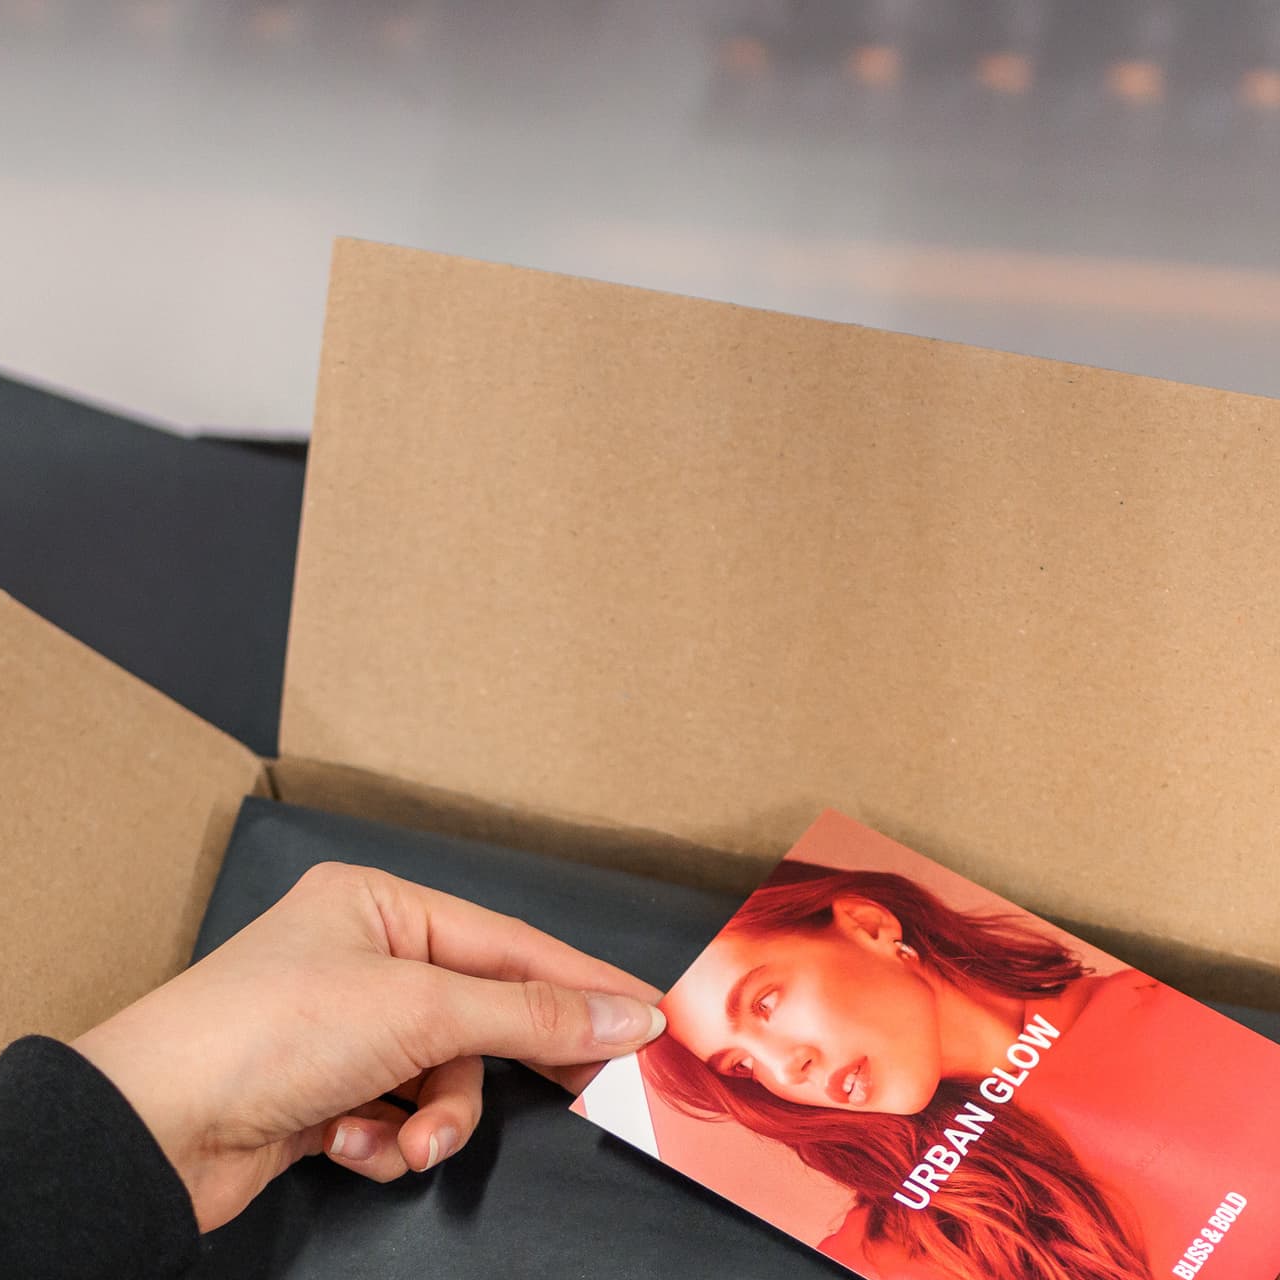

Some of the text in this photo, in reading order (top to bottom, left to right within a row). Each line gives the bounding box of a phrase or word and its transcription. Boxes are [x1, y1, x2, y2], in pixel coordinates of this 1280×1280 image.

[893, 1014, 1061, 1210] URBAN GLOW
[1172, 1192, 1248, 1280] BLISS & BOLD
